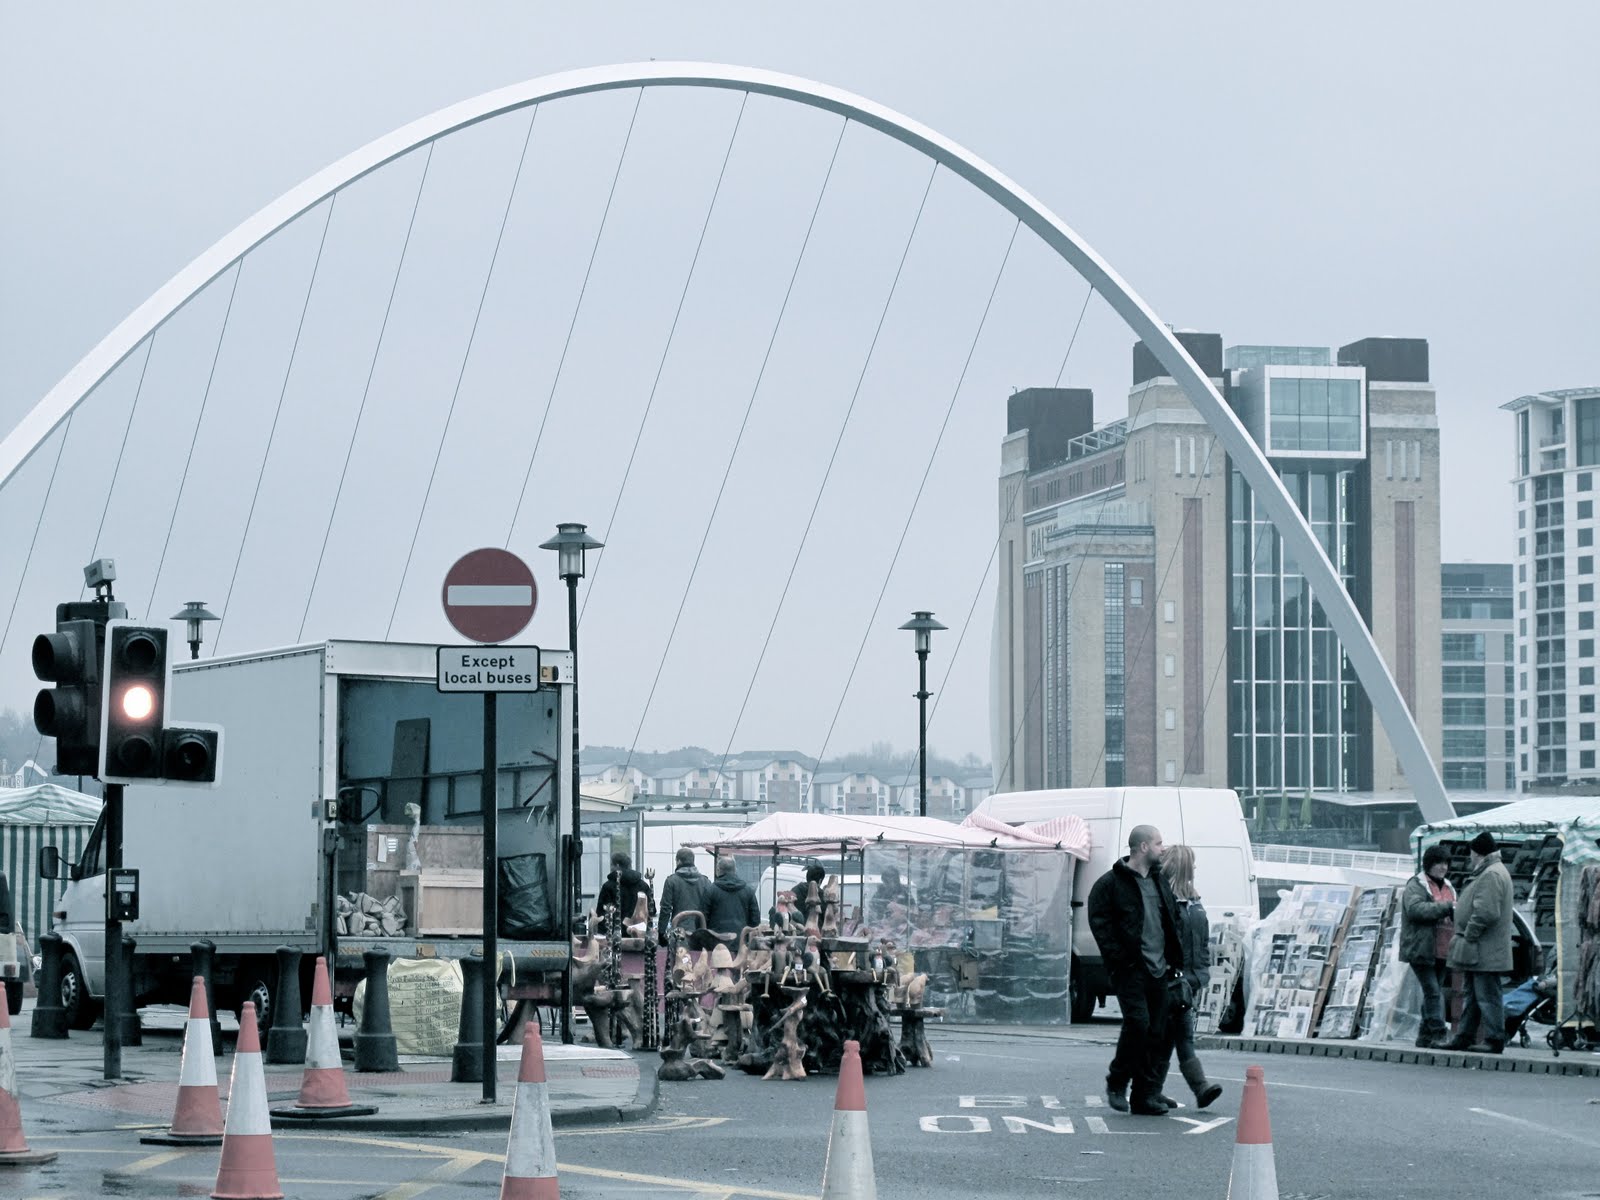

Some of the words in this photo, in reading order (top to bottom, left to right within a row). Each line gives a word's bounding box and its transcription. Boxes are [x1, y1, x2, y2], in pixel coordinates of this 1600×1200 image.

[1031, 523, 1058, 559] BAL
[461, 655, 515, 670] Except
[445, 671, 482, 684] local
[486, 671, 532, 684] buses
[959, 1095, 1186, 1109] BU
[919, 1115, 1236, 1134] ONLY
